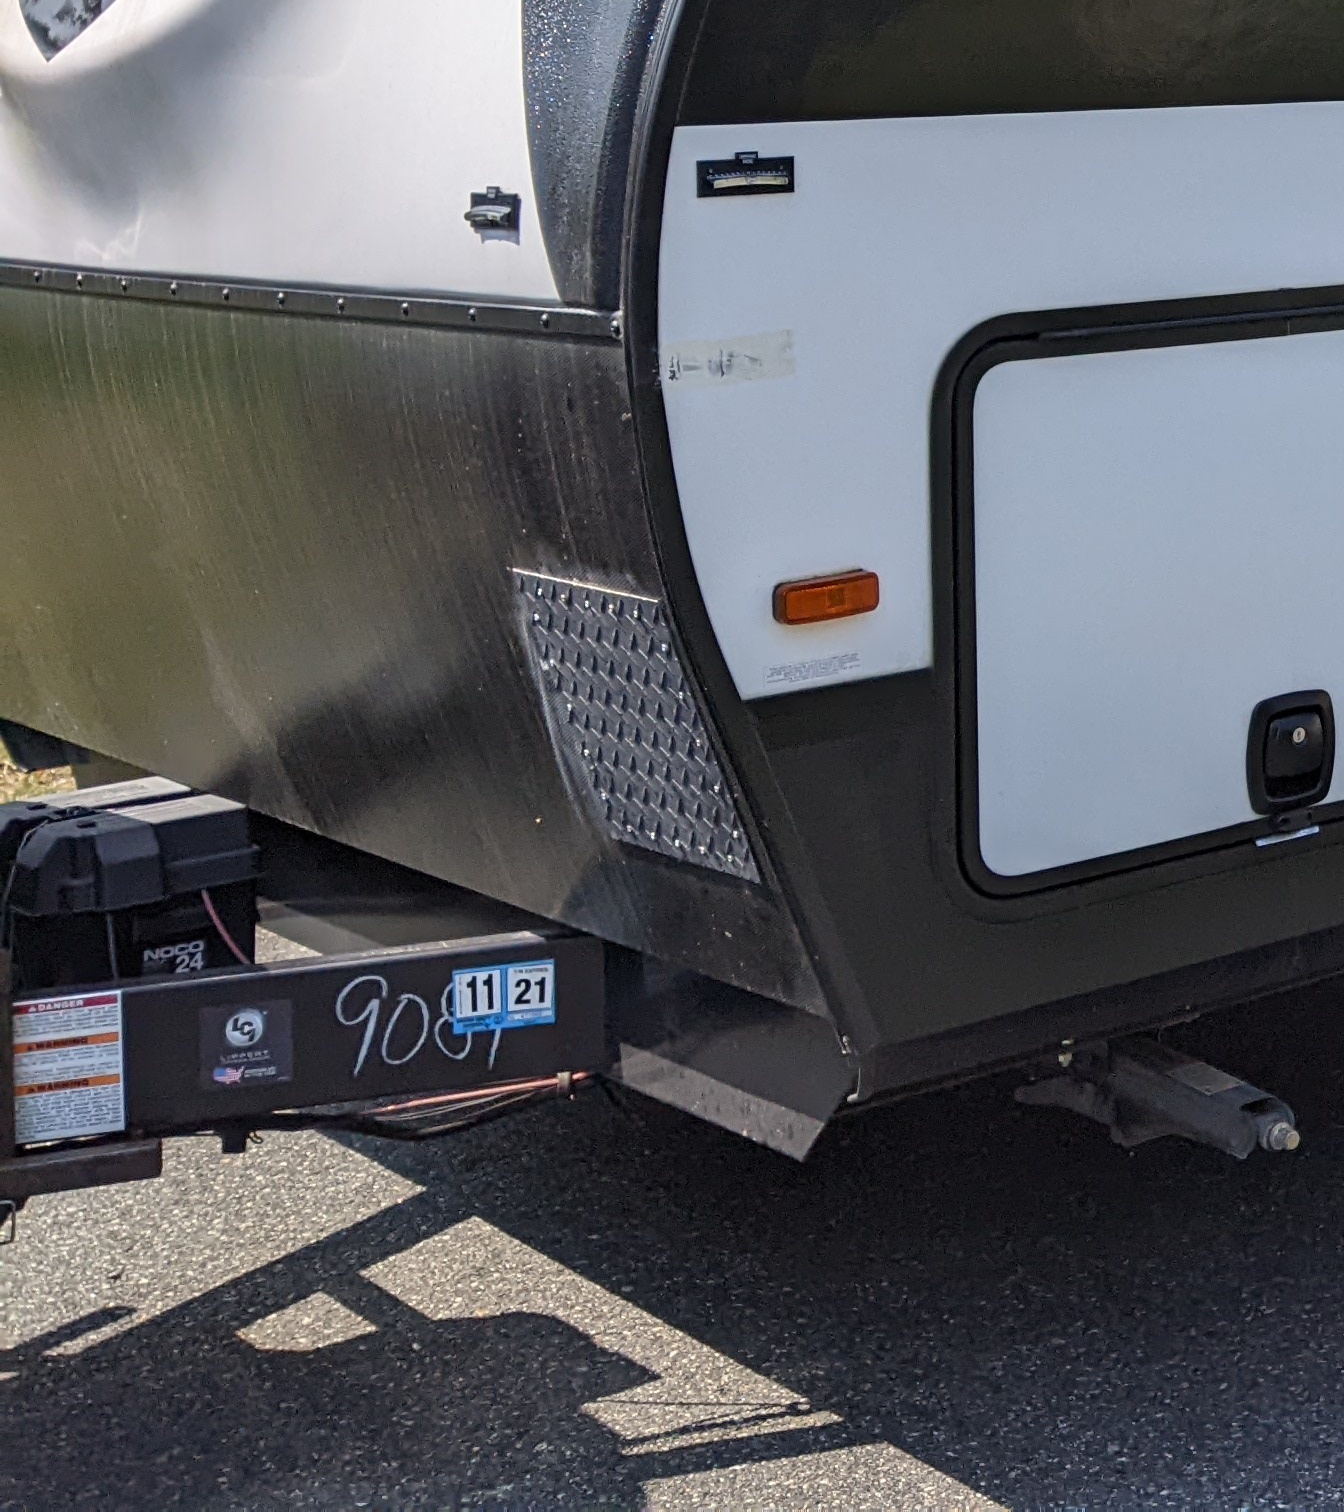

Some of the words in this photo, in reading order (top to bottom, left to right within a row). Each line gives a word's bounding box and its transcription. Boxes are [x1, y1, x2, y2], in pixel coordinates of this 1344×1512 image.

[143, 940, 205, 962] NOCO
[175, 951, 204, 974] 24
[466, 973, 495, 1013] 11
[514, 976, 547, 1006] 21
[38, 999, 85, 1013] DANGER
